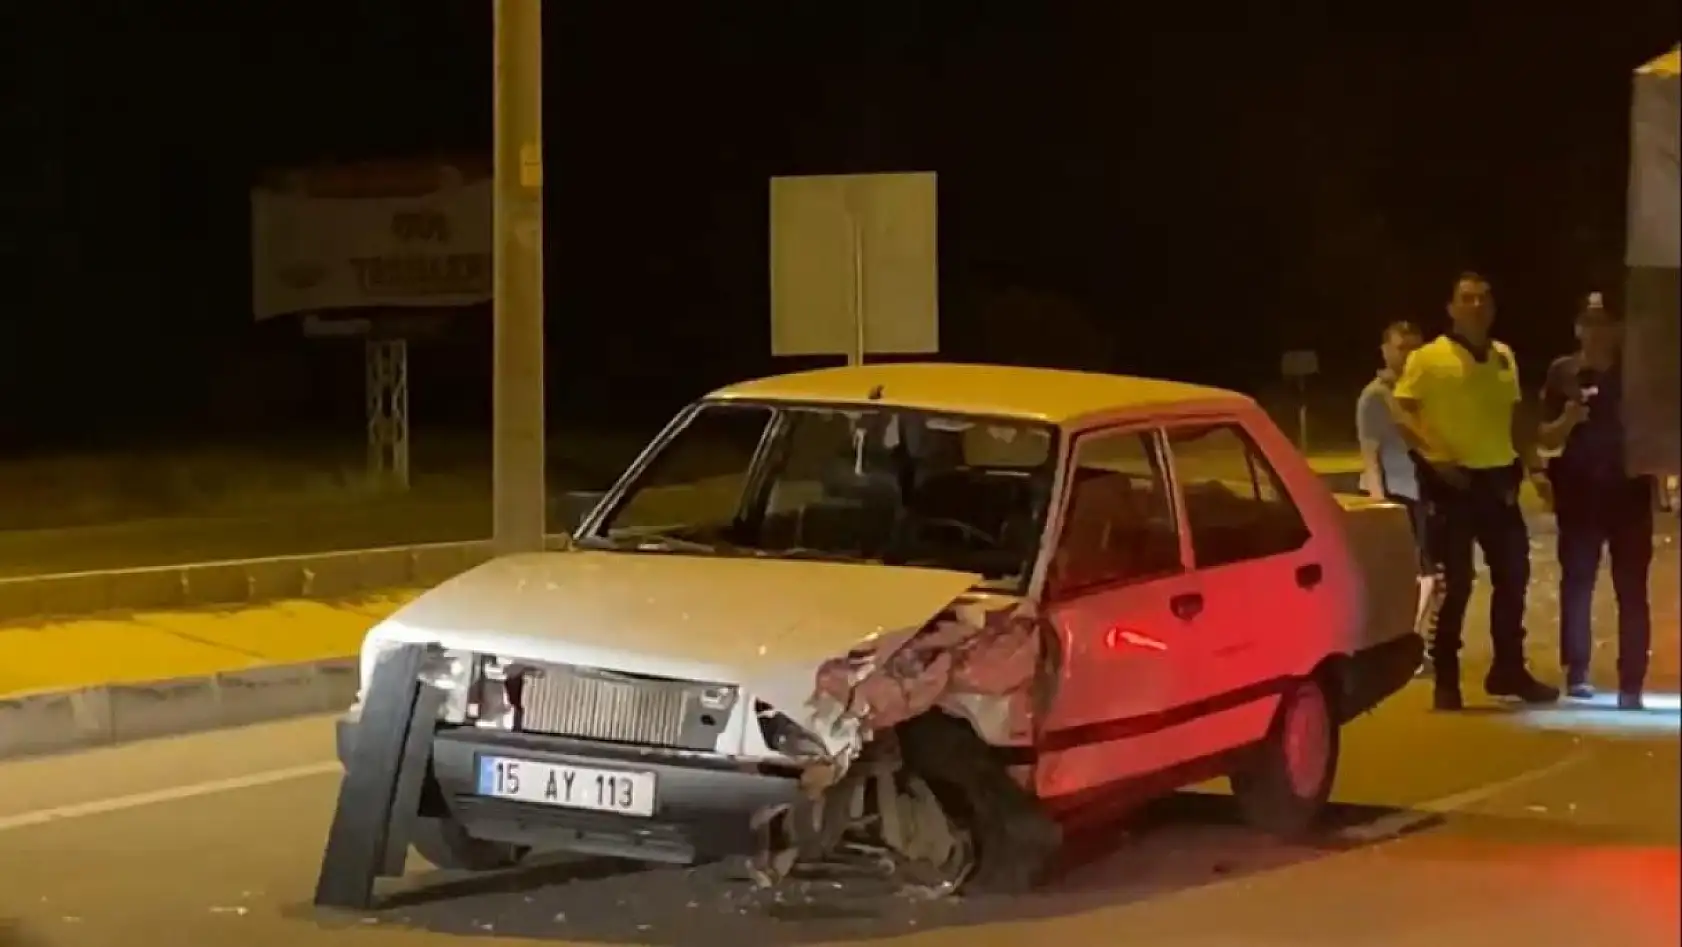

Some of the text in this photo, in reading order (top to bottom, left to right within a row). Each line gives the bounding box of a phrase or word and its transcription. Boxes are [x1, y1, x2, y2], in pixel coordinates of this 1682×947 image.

[496, 763, 633, 807] 15 AY 113
